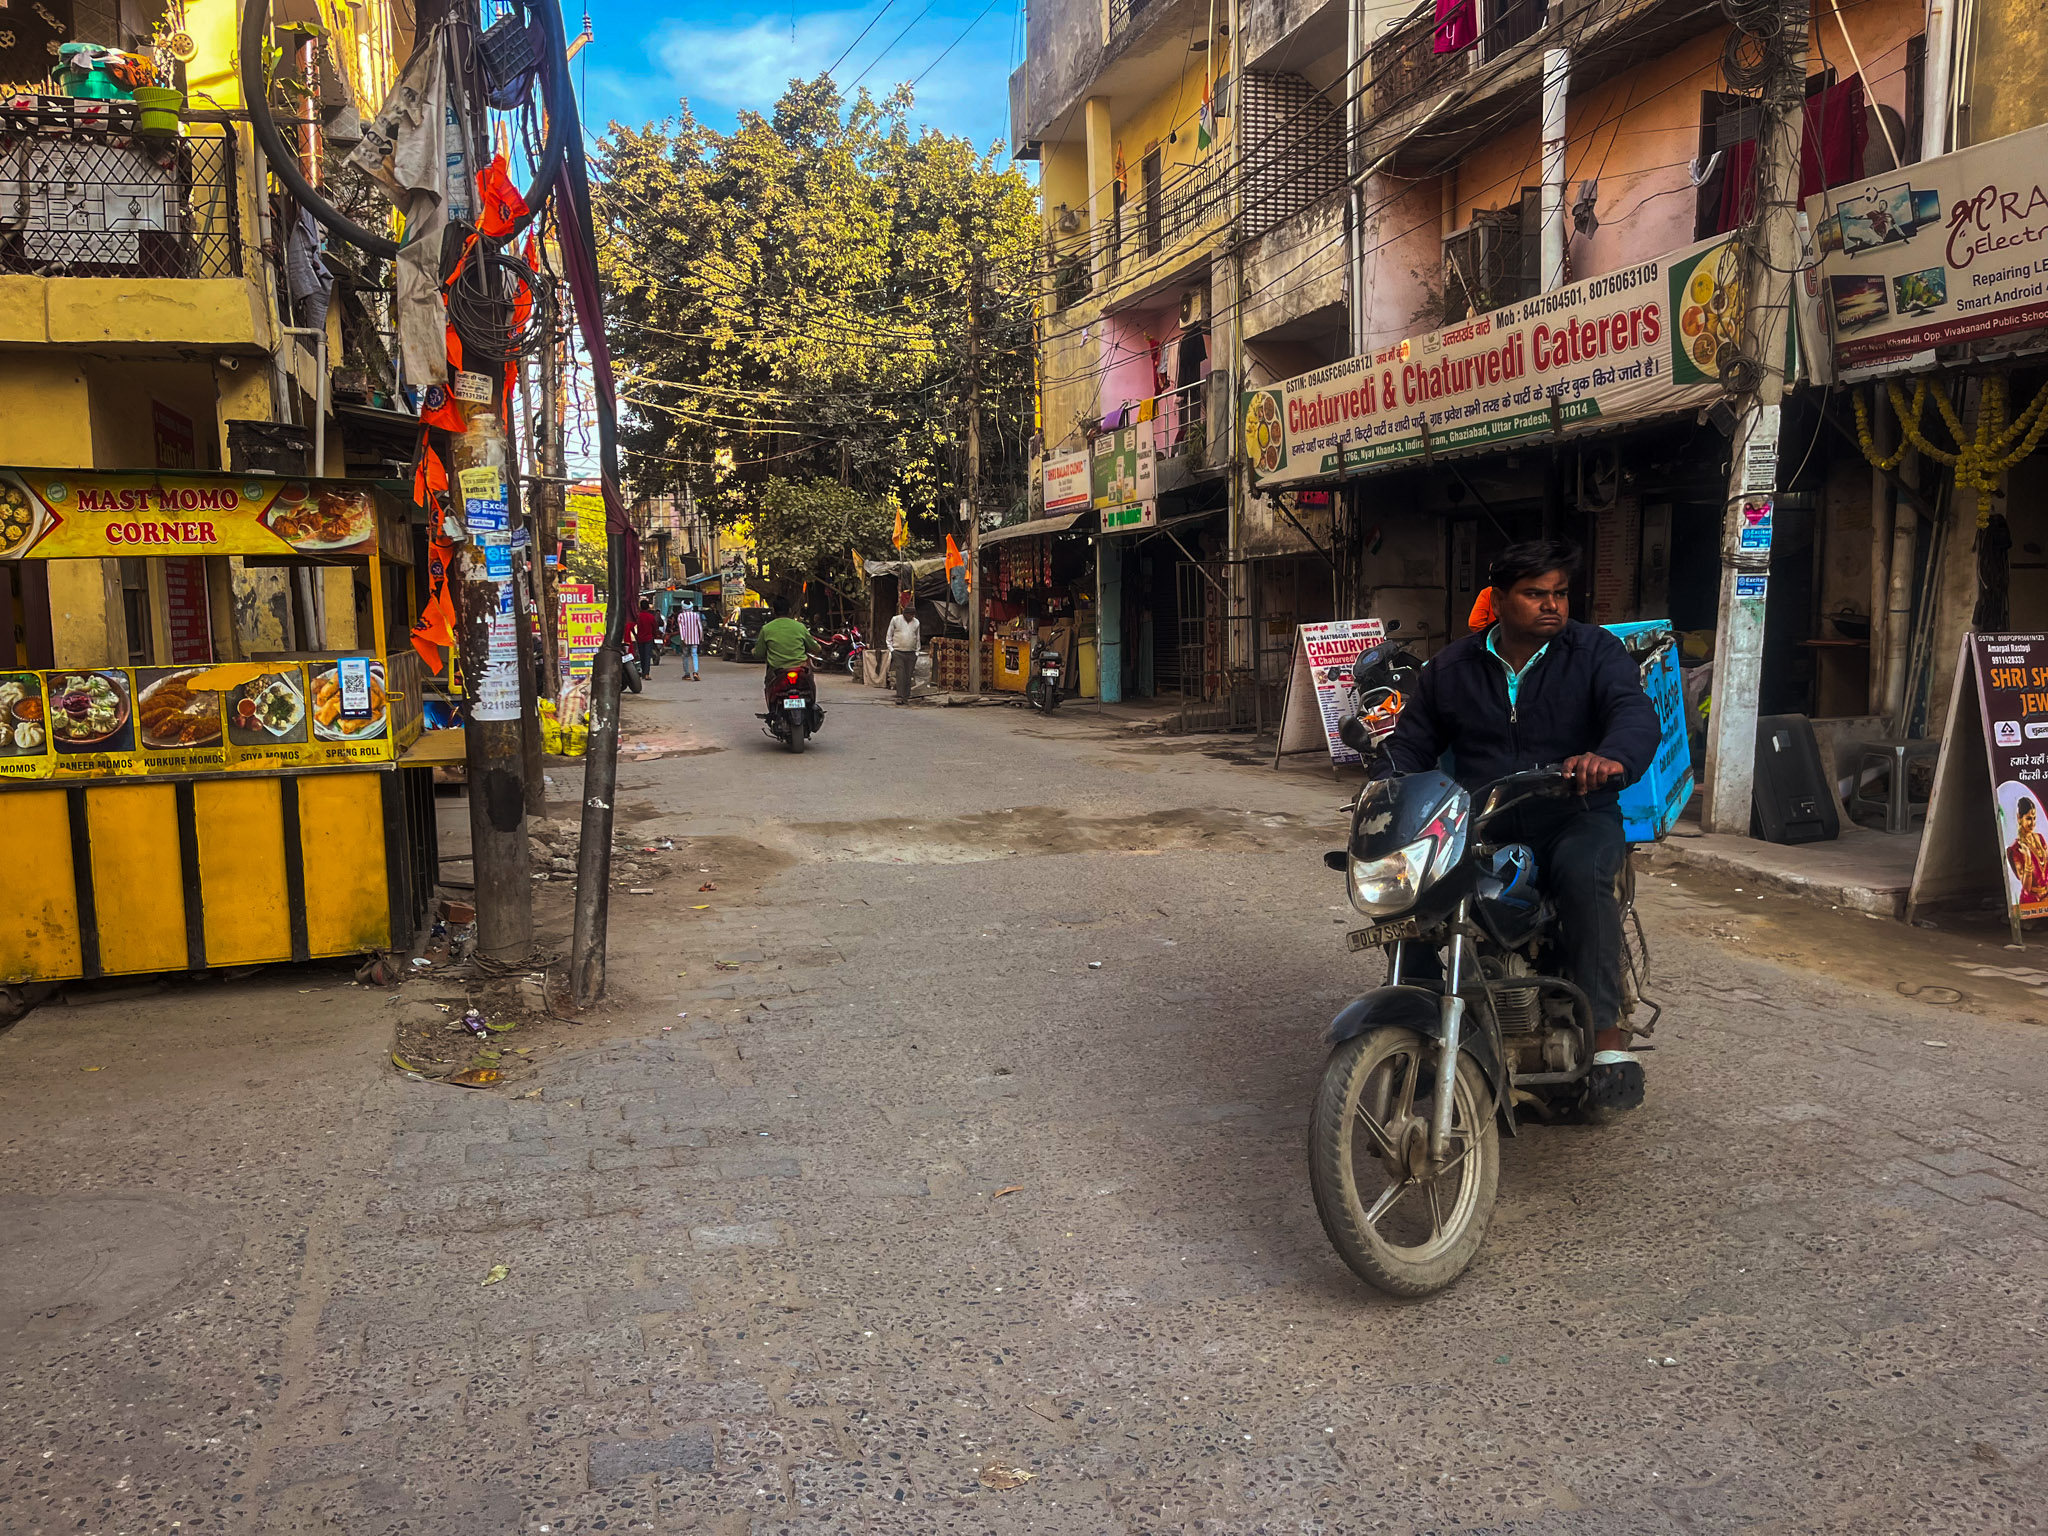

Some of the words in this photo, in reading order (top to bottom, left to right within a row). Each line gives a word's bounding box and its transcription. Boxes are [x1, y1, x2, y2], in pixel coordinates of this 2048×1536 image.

[1973, 265, 2031, 288] Repairing
[1496, 310, 1515, 329] Mob
[1523, 286, 1586, 321] 8447604501,
[1589, 262, 1658, 300] 8076063109
[1956, 294, 1991, 312] Smart
[1994, 282, 2043, 304] Android
[1475, 315, 1491, 335] वाले
[1944, 321, 1991, 337] Vivakanand
[1993, 315, 2020, 328] Public
[1376, 353, 1387, 365] जय
[1288, 375, 1377, 435] Chaturvedi
[1382, 370, 1398, 411] &
[1402, 332, 1525, 405] Chaturvedi
[1532, 304, 1661, 371] Caterers
[1286, 378, 1307, 393] GSTIN:
[1291, 441, 1305, 456] हमारे
[1306, 437, 1316, 452] यहाँ
[1317, 439, 1325, 449] पर
[1373, 420, 1386, 435] पार्टी
[1395, 415, 1410, 432] शादी
[1444, 405, 1462, 424] प्रवेश
[1464, 398, 1480, 417] सभी
[1482, 398, 1500, 413] तरह
[1502, 392, 1511, 409] के
[1513, 385, 1531, 405] पार्टी
[1533, 384, 1543, 401] के
[1545, 377, 1570, 399] आर्डर
[1572, 376, 1590, 398] बुक
[1593, 366, 1615, 388] किये
[1618, 360, 1641, 380] जाते
[1361, 449, 1375, 460] Nyay
[1376, 442, 1404, 456] Khand-3,
[1449, 425, 1490, 442] Ghaziabad,
[1492, 421, 1511, 433] Uttar
[1514, 411, 1551, 429] Pradesh,
[77, 489, 152, 512] MAST
[159, 488, 240, 512] MOMO
[105, 521, 219, 545] CORNER
[560, 593, 588, 603] OBILE
[571, 609, 604, 624] मसाले
[572, 632, 605, 646] मसाले
[1319, 655, 1356, 665] Chaturvedi
[1990, 667, 2028, 689] SHRI
[144, 755, 187, 767] KURKURE
[189, 753, 224, 765] MOMOS
[325, 748, 358, 758] SPRING
[360, 747, 381, 756] ROLL
[0, 764, 37, 774] MOMOS
[60, 761, 95, 771] PANEER
[97, 759, 133, 770] MOMOS
